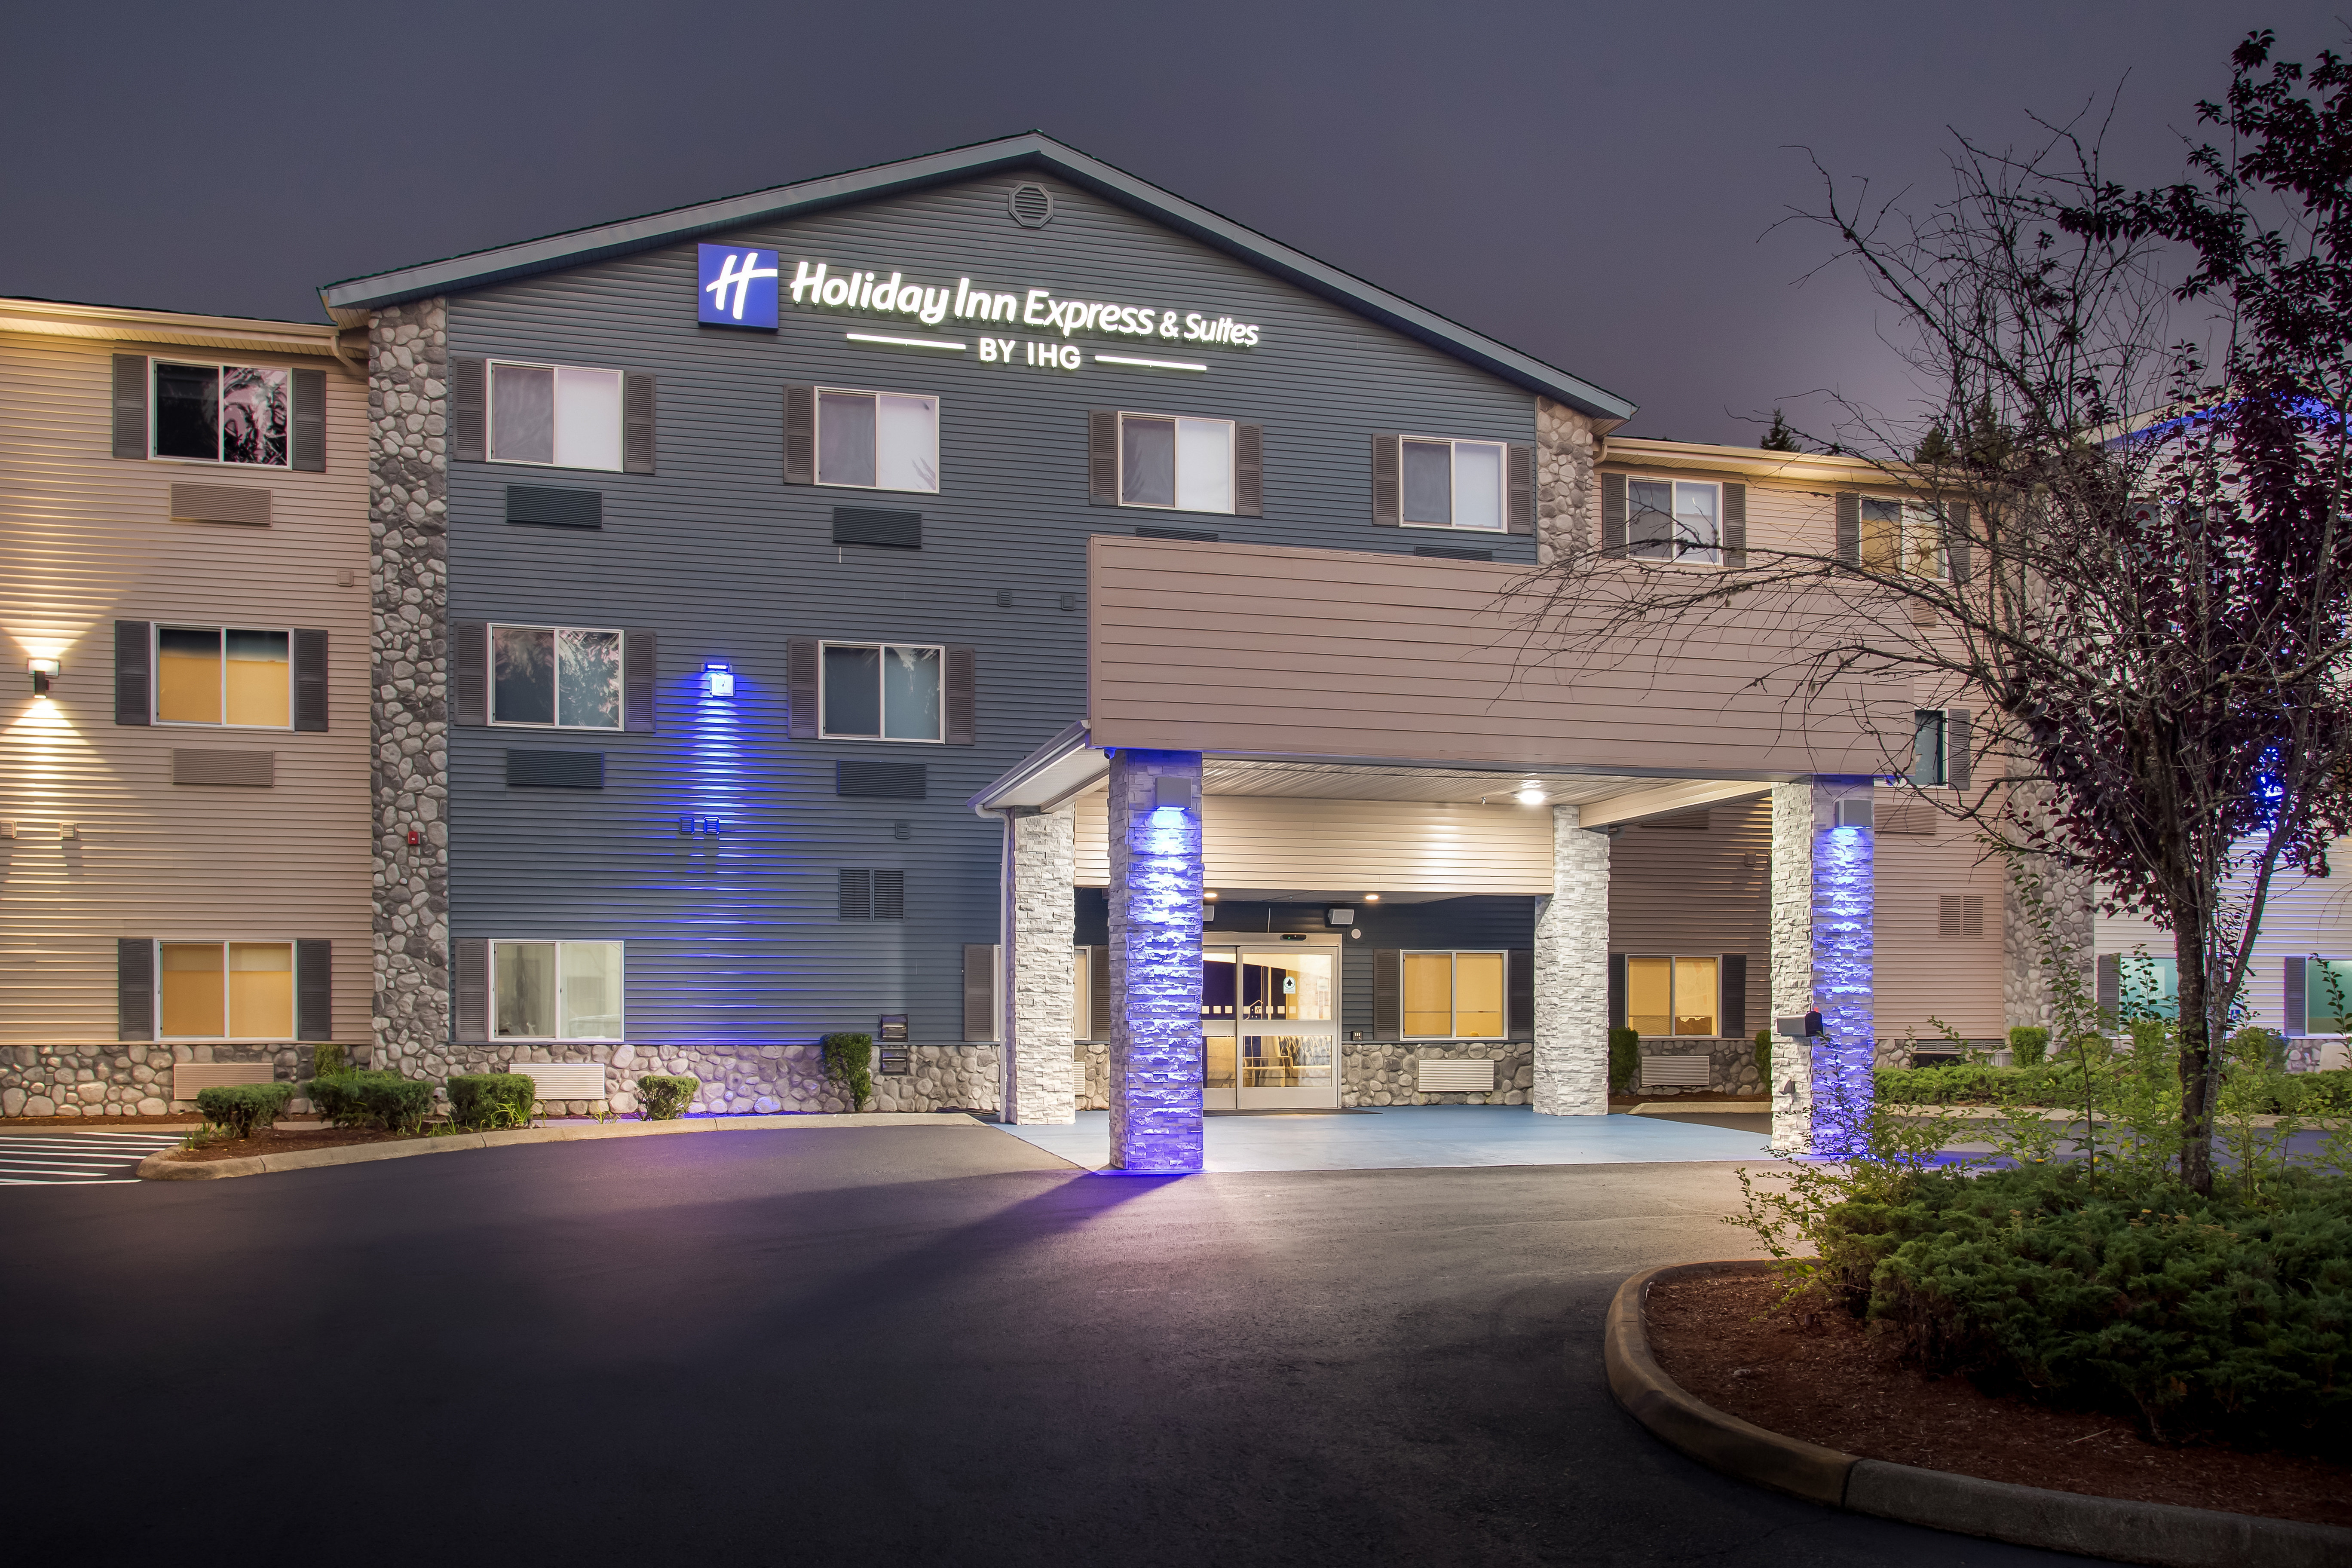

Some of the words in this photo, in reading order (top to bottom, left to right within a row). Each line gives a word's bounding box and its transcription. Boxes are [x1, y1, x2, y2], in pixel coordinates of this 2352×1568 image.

[790, 261, 950, 325] Holiday
[954, 277, 1017, 322] Inn
[1023, 289, 1155, 337] Express
[1160, 311, 1179, 338] &
[1183, 313, 1259, 346] Suites
[980, 337, 1016, 363] BY
[1027, 341, 1081, 370] IHG
